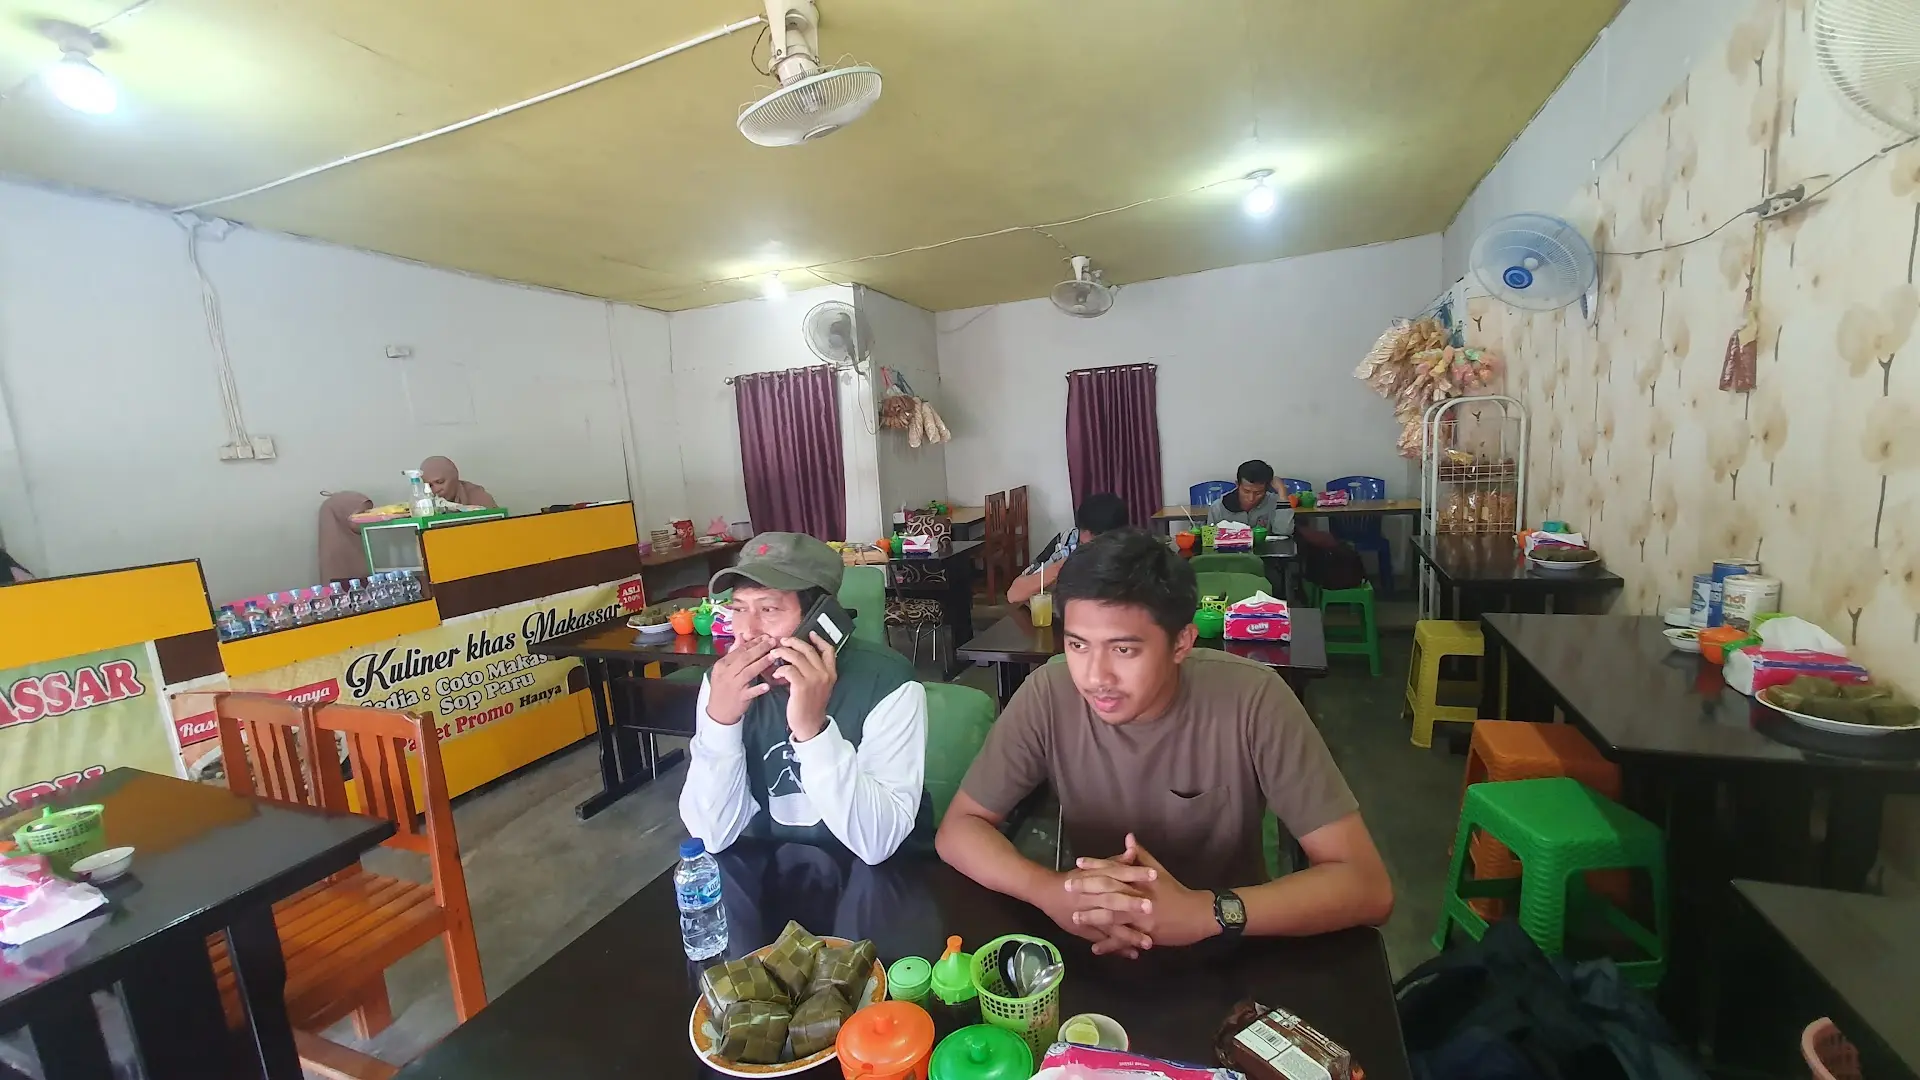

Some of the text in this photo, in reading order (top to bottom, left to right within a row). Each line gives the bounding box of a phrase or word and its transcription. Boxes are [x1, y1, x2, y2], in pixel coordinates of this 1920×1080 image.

[622, 585, 640, 597] ASLI
[345, 603, 621, 698] Kuliner khas Makassar
[435, 671, 485, 696] Coto
[486, 654, 551, 680] Makas
[440, 673, 535, 716] Sop Paru
[179, 720, 218, 738] Ras
[455, 702, 515, 734] Promo
[520, 685, 562, 708] Hanya
